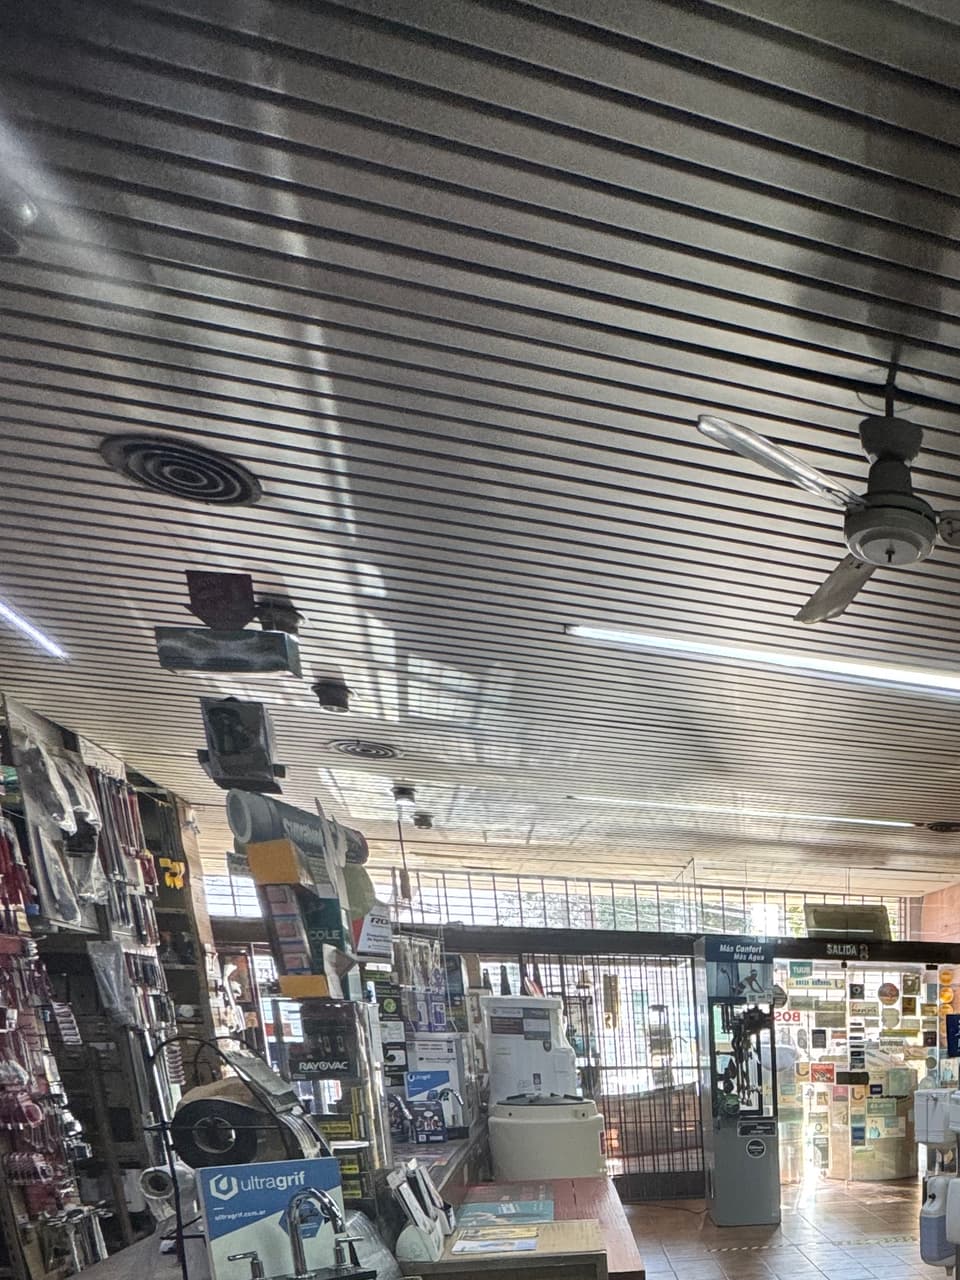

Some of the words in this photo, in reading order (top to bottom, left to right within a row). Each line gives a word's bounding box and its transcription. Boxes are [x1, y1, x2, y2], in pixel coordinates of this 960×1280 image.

[736, 944, 763, 954] Confort
[826, 943, 857, 956] SALIDA
[748, 953, 765, 962] Agua
[298, 1060, 349, 1071] RAYOVAC
[240, 1170, 305, 1192] ultragrif
